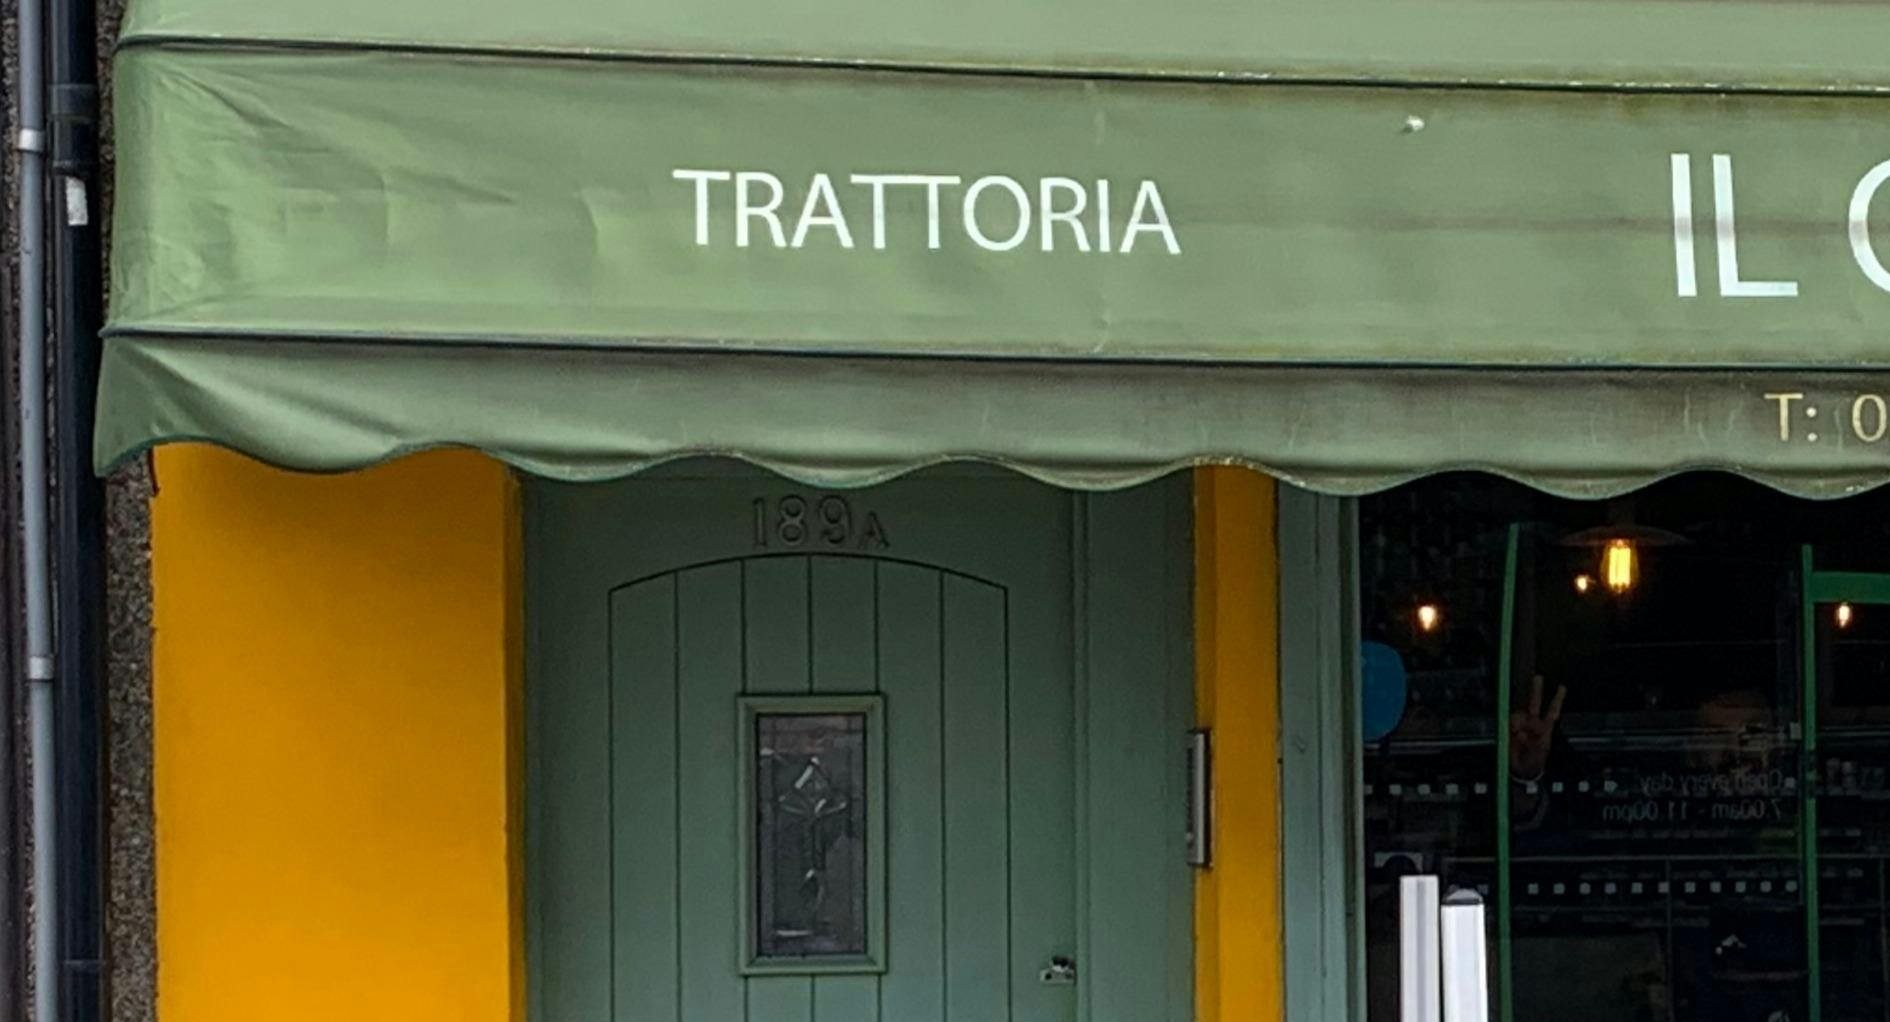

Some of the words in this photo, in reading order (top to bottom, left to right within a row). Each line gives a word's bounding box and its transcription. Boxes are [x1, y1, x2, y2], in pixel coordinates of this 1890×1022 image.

[672, 168, 1182, 256] TRATTORIA
[1670, 152, 1799, 299] IL
[1763, 393, 1818, 441] T:
